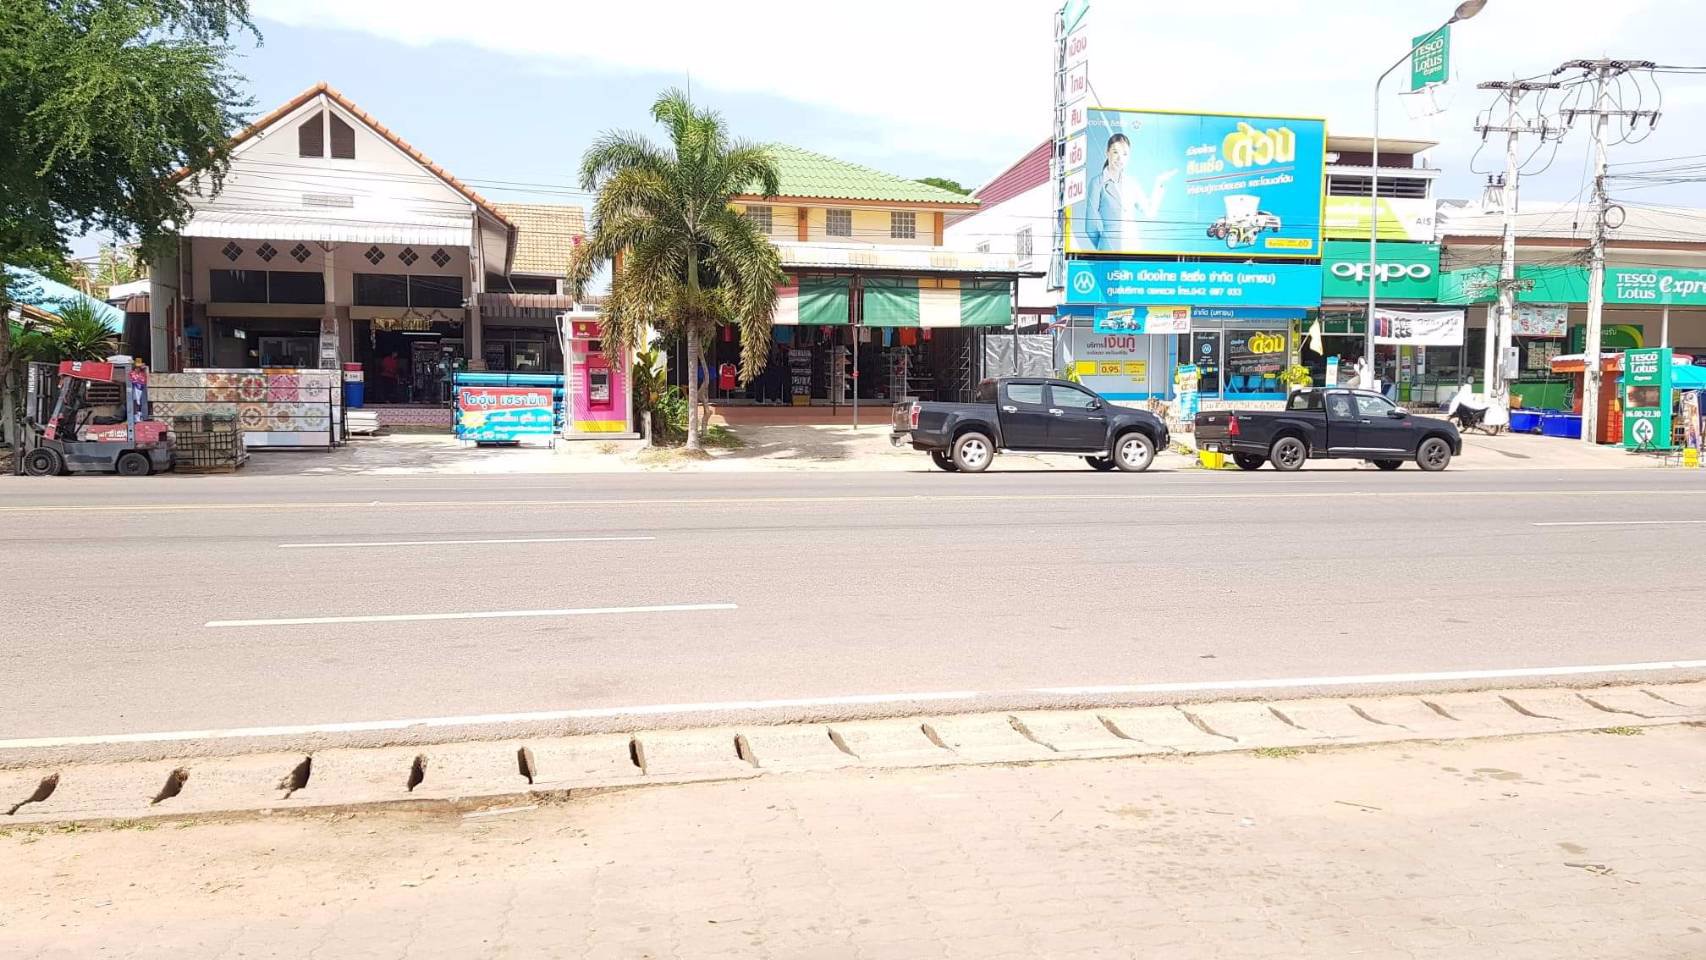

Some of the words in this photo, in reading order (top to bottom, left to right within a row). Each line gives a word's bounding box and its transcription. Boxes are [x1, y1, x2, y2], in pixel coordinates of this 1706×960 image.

[1069, 36, 1087, 57] เมือง
[1415, 37, 1444, 58] TESCO
[1415, 55, 1443, 73] Lotus
[1071, 73, 1083, 93] ไทย
[1222, 121, 1296, 168] ด่วน
[1068, 181, 1083, 199] ด่วน
[1416, 217, 1432, 226] AIS
[1106, 270, 1134, 282] บริษัท
[1136, 267, 1177, 282] เมืองไทย
[1209, 270, 1234, 283] จำกัด
[1237, 272, 1276, 286] (มหาชน)
[1616, 272, 1657, 284] TESCO
[1618, 286, 1656, 299] Lotus
[1193, 308, 1209, 316] จำกัด
[1210, 309, 1234, 318] (มหาชน)
[1247, 331, 1285, 354] ด่วน
[1629, 351, 1658, 362] TESCO
[1101, 366, 1119, 374] 0.95
[1631, 364, 1658, 373] Lotus
[28, 367, 36, 393] NISSAN
